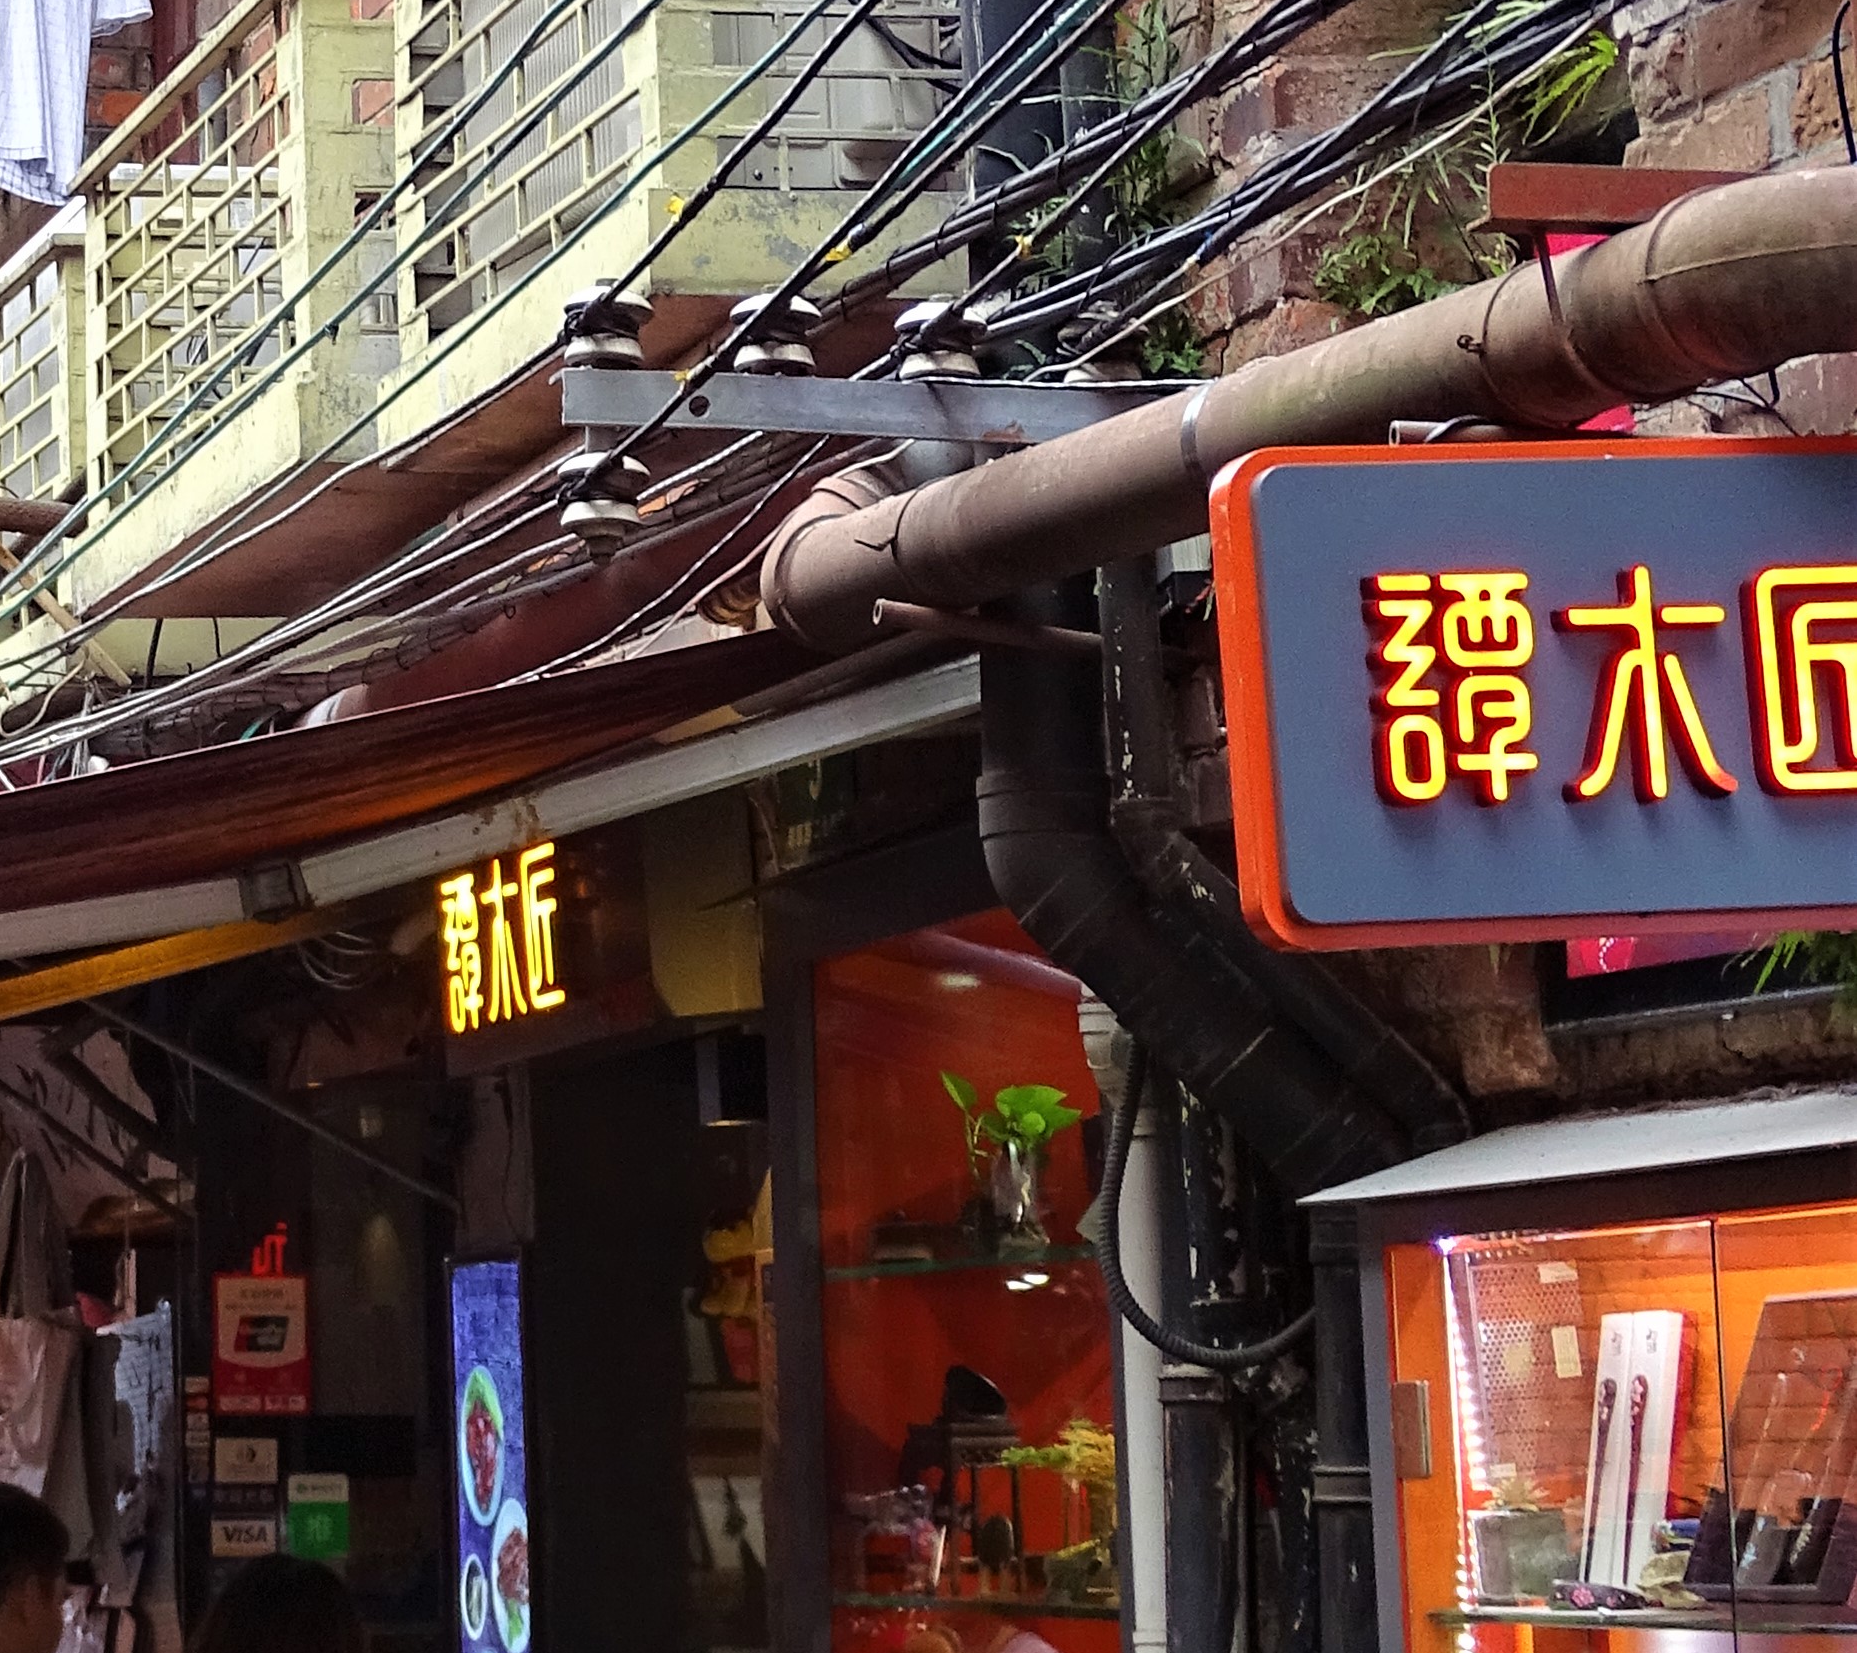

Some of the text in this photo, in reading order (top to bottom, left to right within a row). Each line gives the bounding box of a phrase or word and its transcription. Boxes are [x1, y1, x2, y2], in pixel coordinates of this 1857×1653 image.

[1368, 564, 1857, 802] 譚木匠
[440, 842, 566, 1033] 譚木匠
[223, 1526, 267, 1545] VISA
